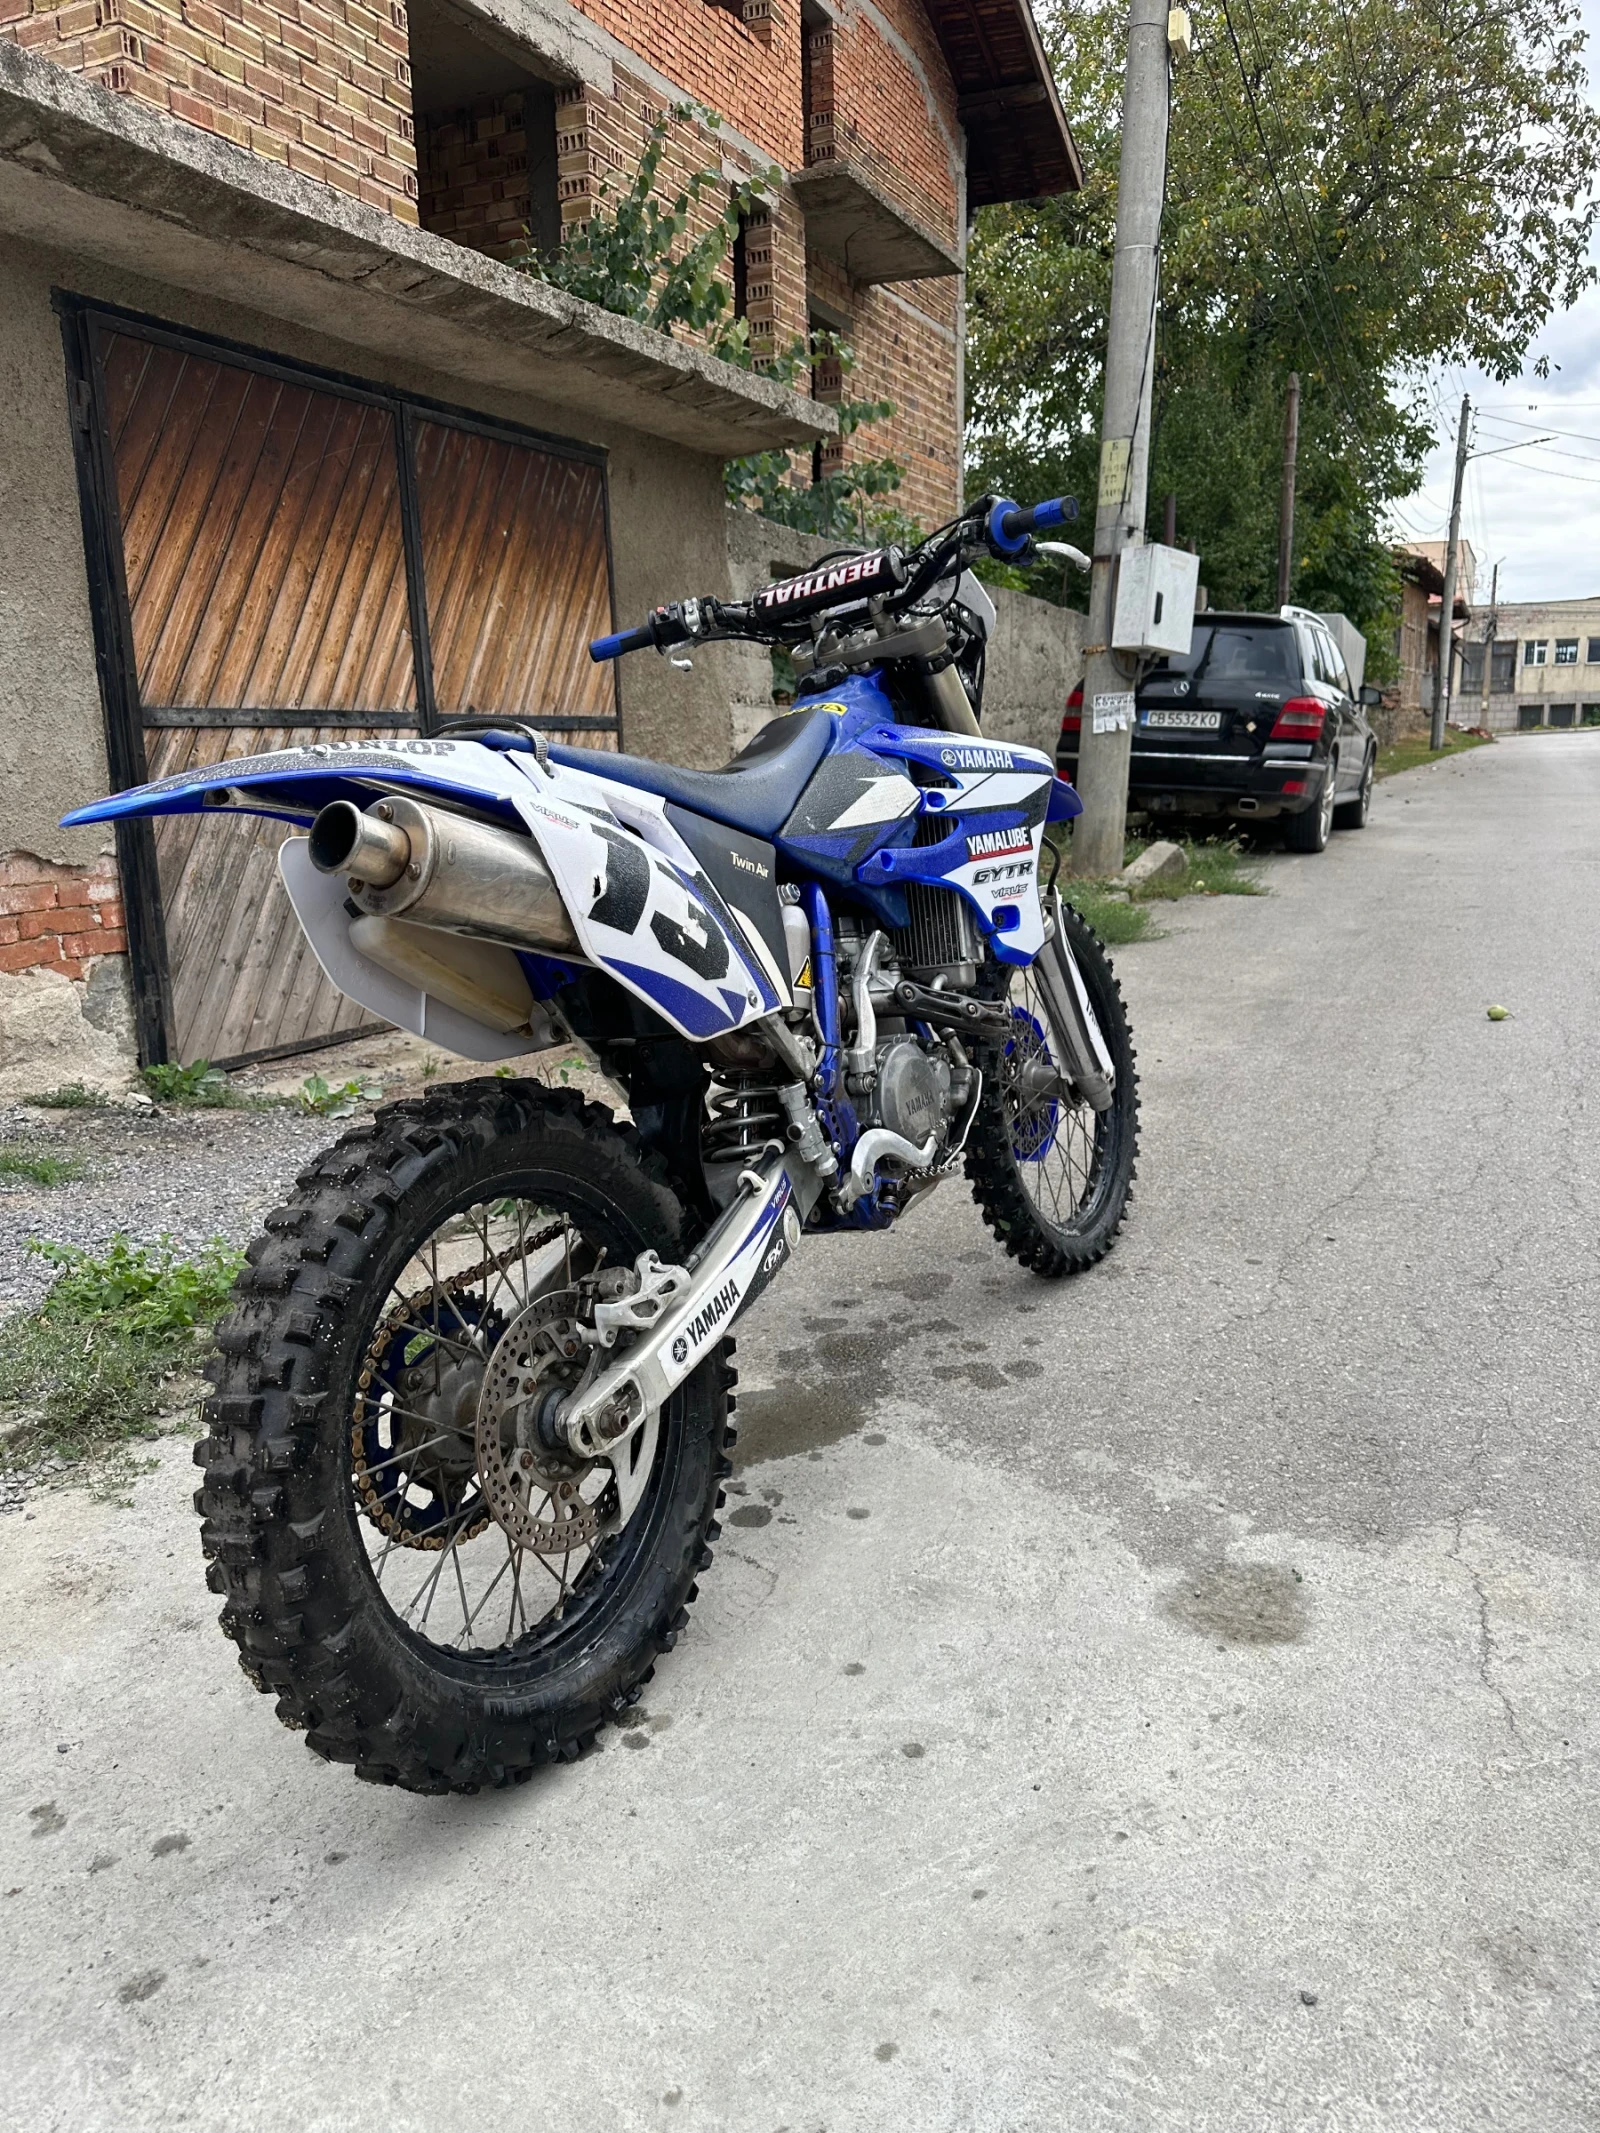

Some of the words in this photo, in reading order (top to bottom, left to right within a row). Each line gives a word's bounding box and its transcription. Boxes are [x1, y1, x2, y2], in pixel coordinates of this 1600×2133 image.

[760, 556, 883, 607] RENTHAL
[1167, 713, 1198, 726] 5532
[955, 749, 1014, 769] YAMAHA
[966, 826, 1030, 856] YAMALUBE
[730, 850, 756, 873] Twin
[756, 862, 769, 878] Air
[971, 858, 1034, 886] GYTR
[991, 883, 1028, 899] VIRUS
[905, 1089, 935, 1116] YAMAHA
[685, 1278, 741, 1347] YAMAHA
